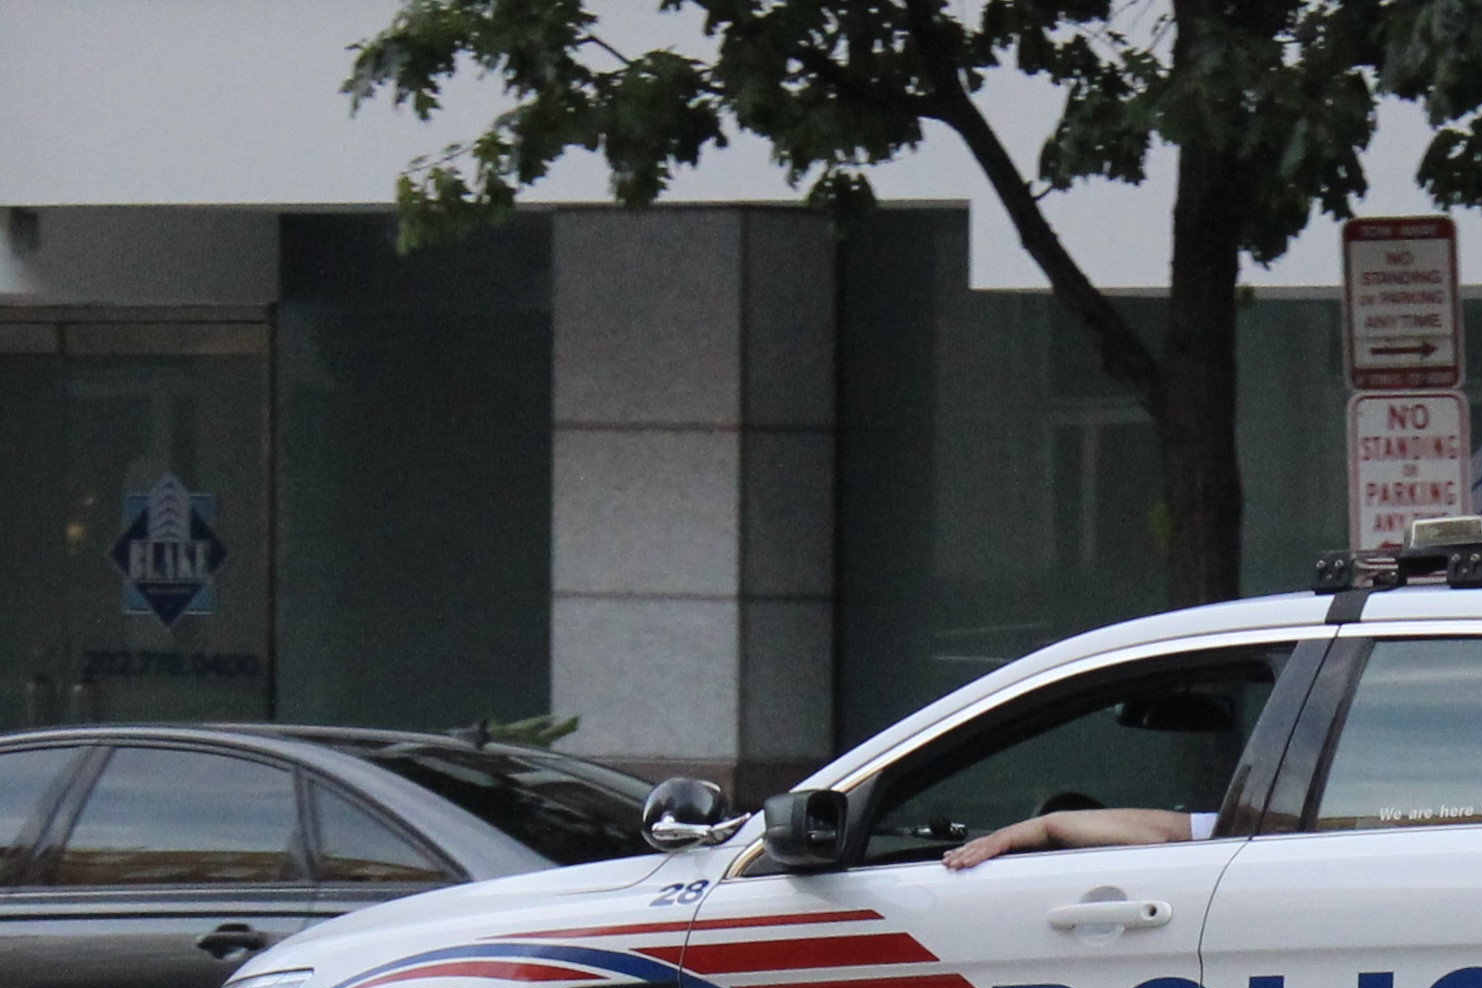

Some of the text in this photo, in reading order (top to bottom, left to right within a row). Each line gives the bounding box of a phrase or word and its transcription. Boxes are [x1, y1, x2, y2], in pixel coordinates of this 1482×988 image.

[1386, 251, 1415, 266] NO
[1361, 271, 1443, 286] STANDING
[1379, 290, 1444, 305] PARKING
[1388, 404, 1430, 430] NO
[1361, 435, 1457, 461] STANDING
[1366, 481, 1457, 506] PARKING
[1379, 807, 1401, 821] We
[1409, 808, 1433, 820] are
[1440, 803, 1474, 818] here
[649, 879, 710, 907] 28
